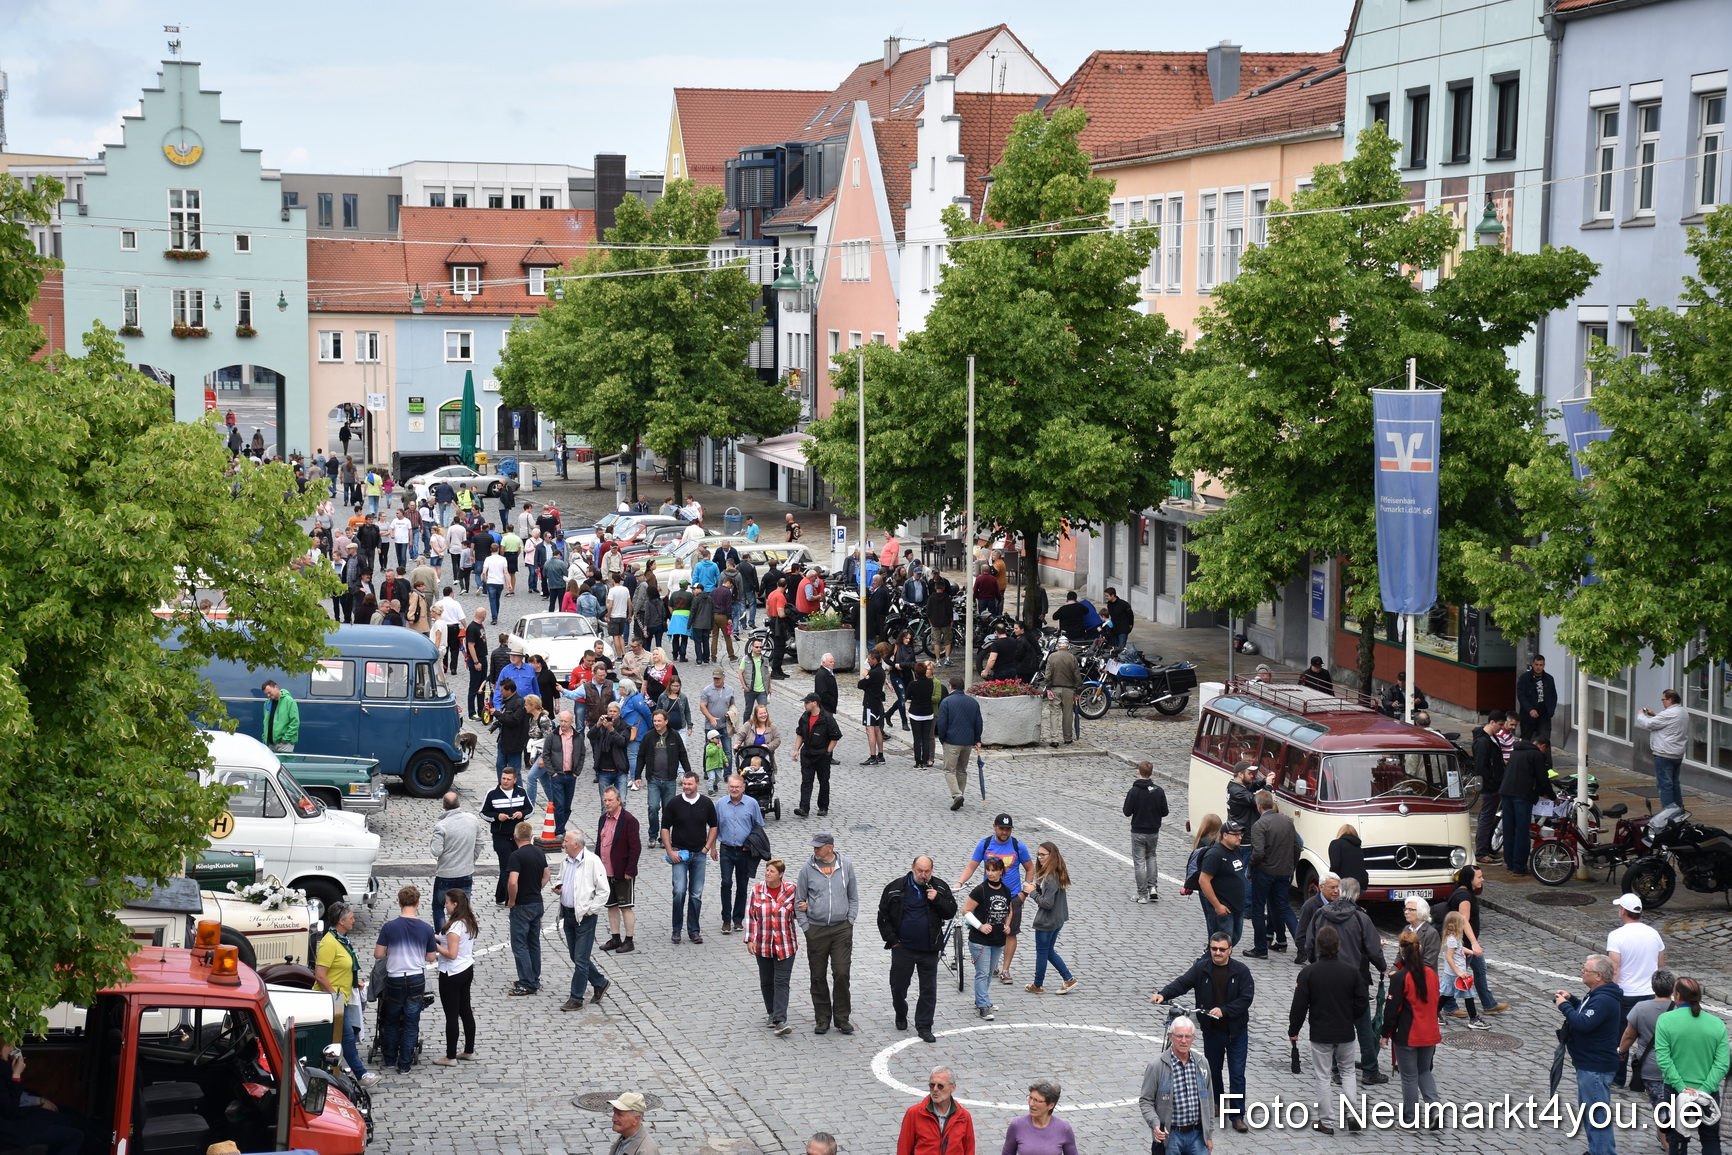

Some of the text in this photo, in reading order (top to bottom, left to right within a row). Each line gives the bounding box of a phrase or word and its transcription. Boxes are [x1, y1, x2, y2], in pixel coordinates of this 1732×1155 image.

[513, 414, 519, 426] P
[1423, 507, 1432, 515] eG
[838, 530, 844, 538] P
[213, 817, 227, 833] H
[249, 914, 287, 927] Hochzeits
[273, 921, 300, 929] Kutsche
